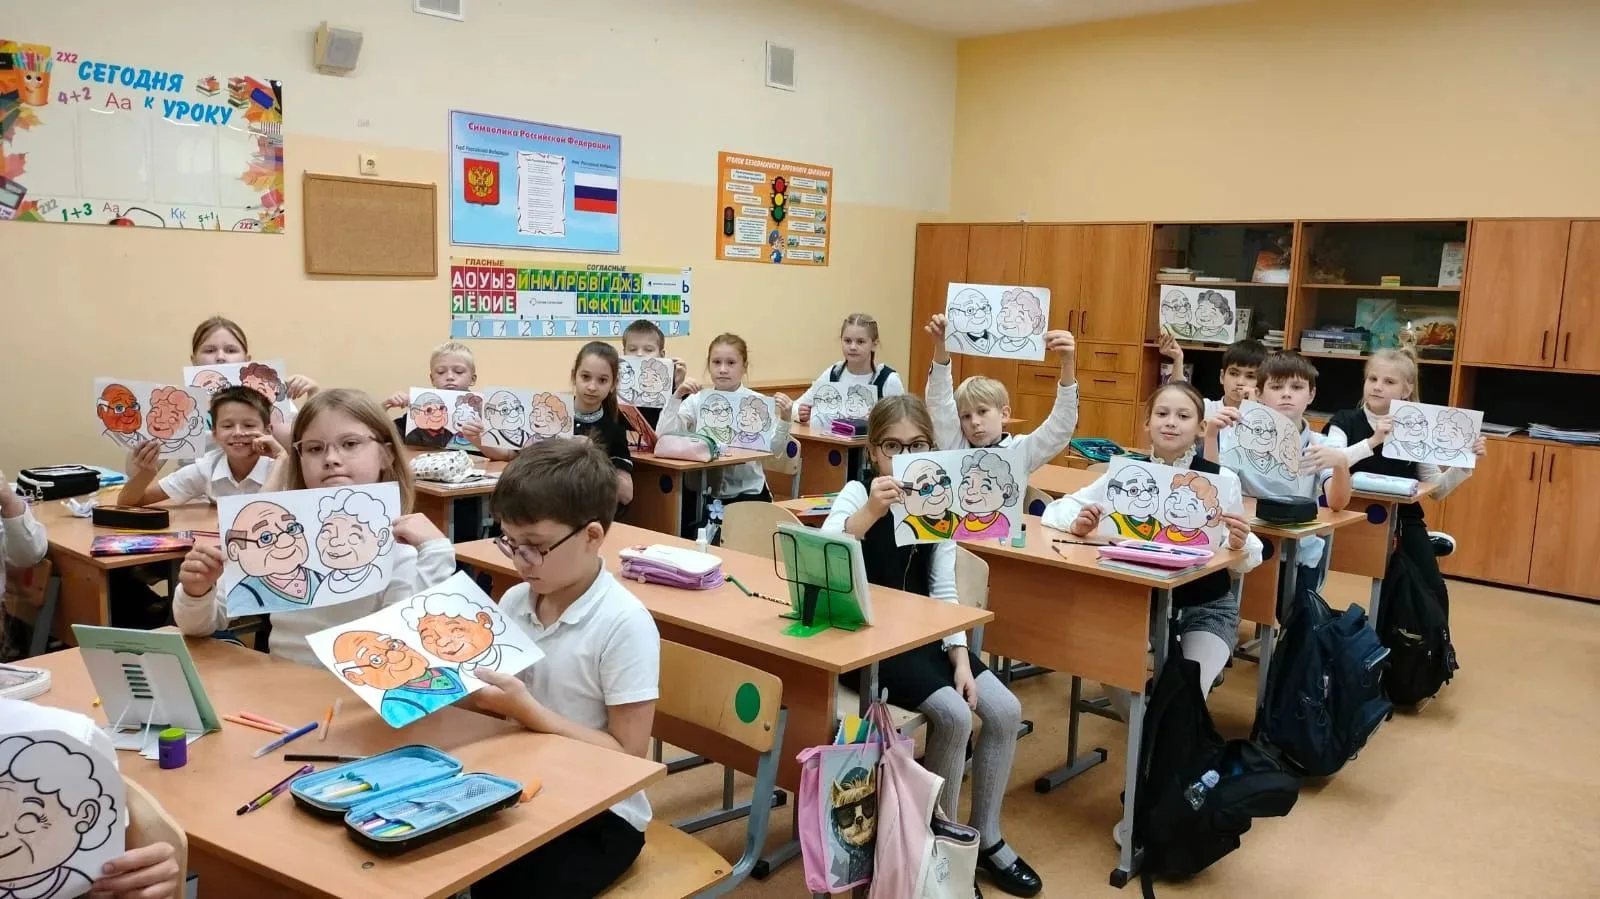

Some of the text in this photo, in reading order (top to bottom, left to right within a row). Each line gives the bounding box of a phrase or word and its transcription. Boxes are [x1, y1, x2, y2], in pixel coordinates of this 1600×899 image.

[78, 60, 184, 93] СЕГОДНЯ
[163, 99, 233, 126] УРОКУ
[468, 122, 611, 150] Символика Российской Федерации
[465, 258, 504, 266] ГЛАСНЫЕ
[587, 264, 626, 272] СОГЛАСНЫЕ
[522, 321, 531, 336] 2
[546, 321, 555, 336] 3
[591, 320, 599, 336] 5
[614, 320, 621, 335] 6
